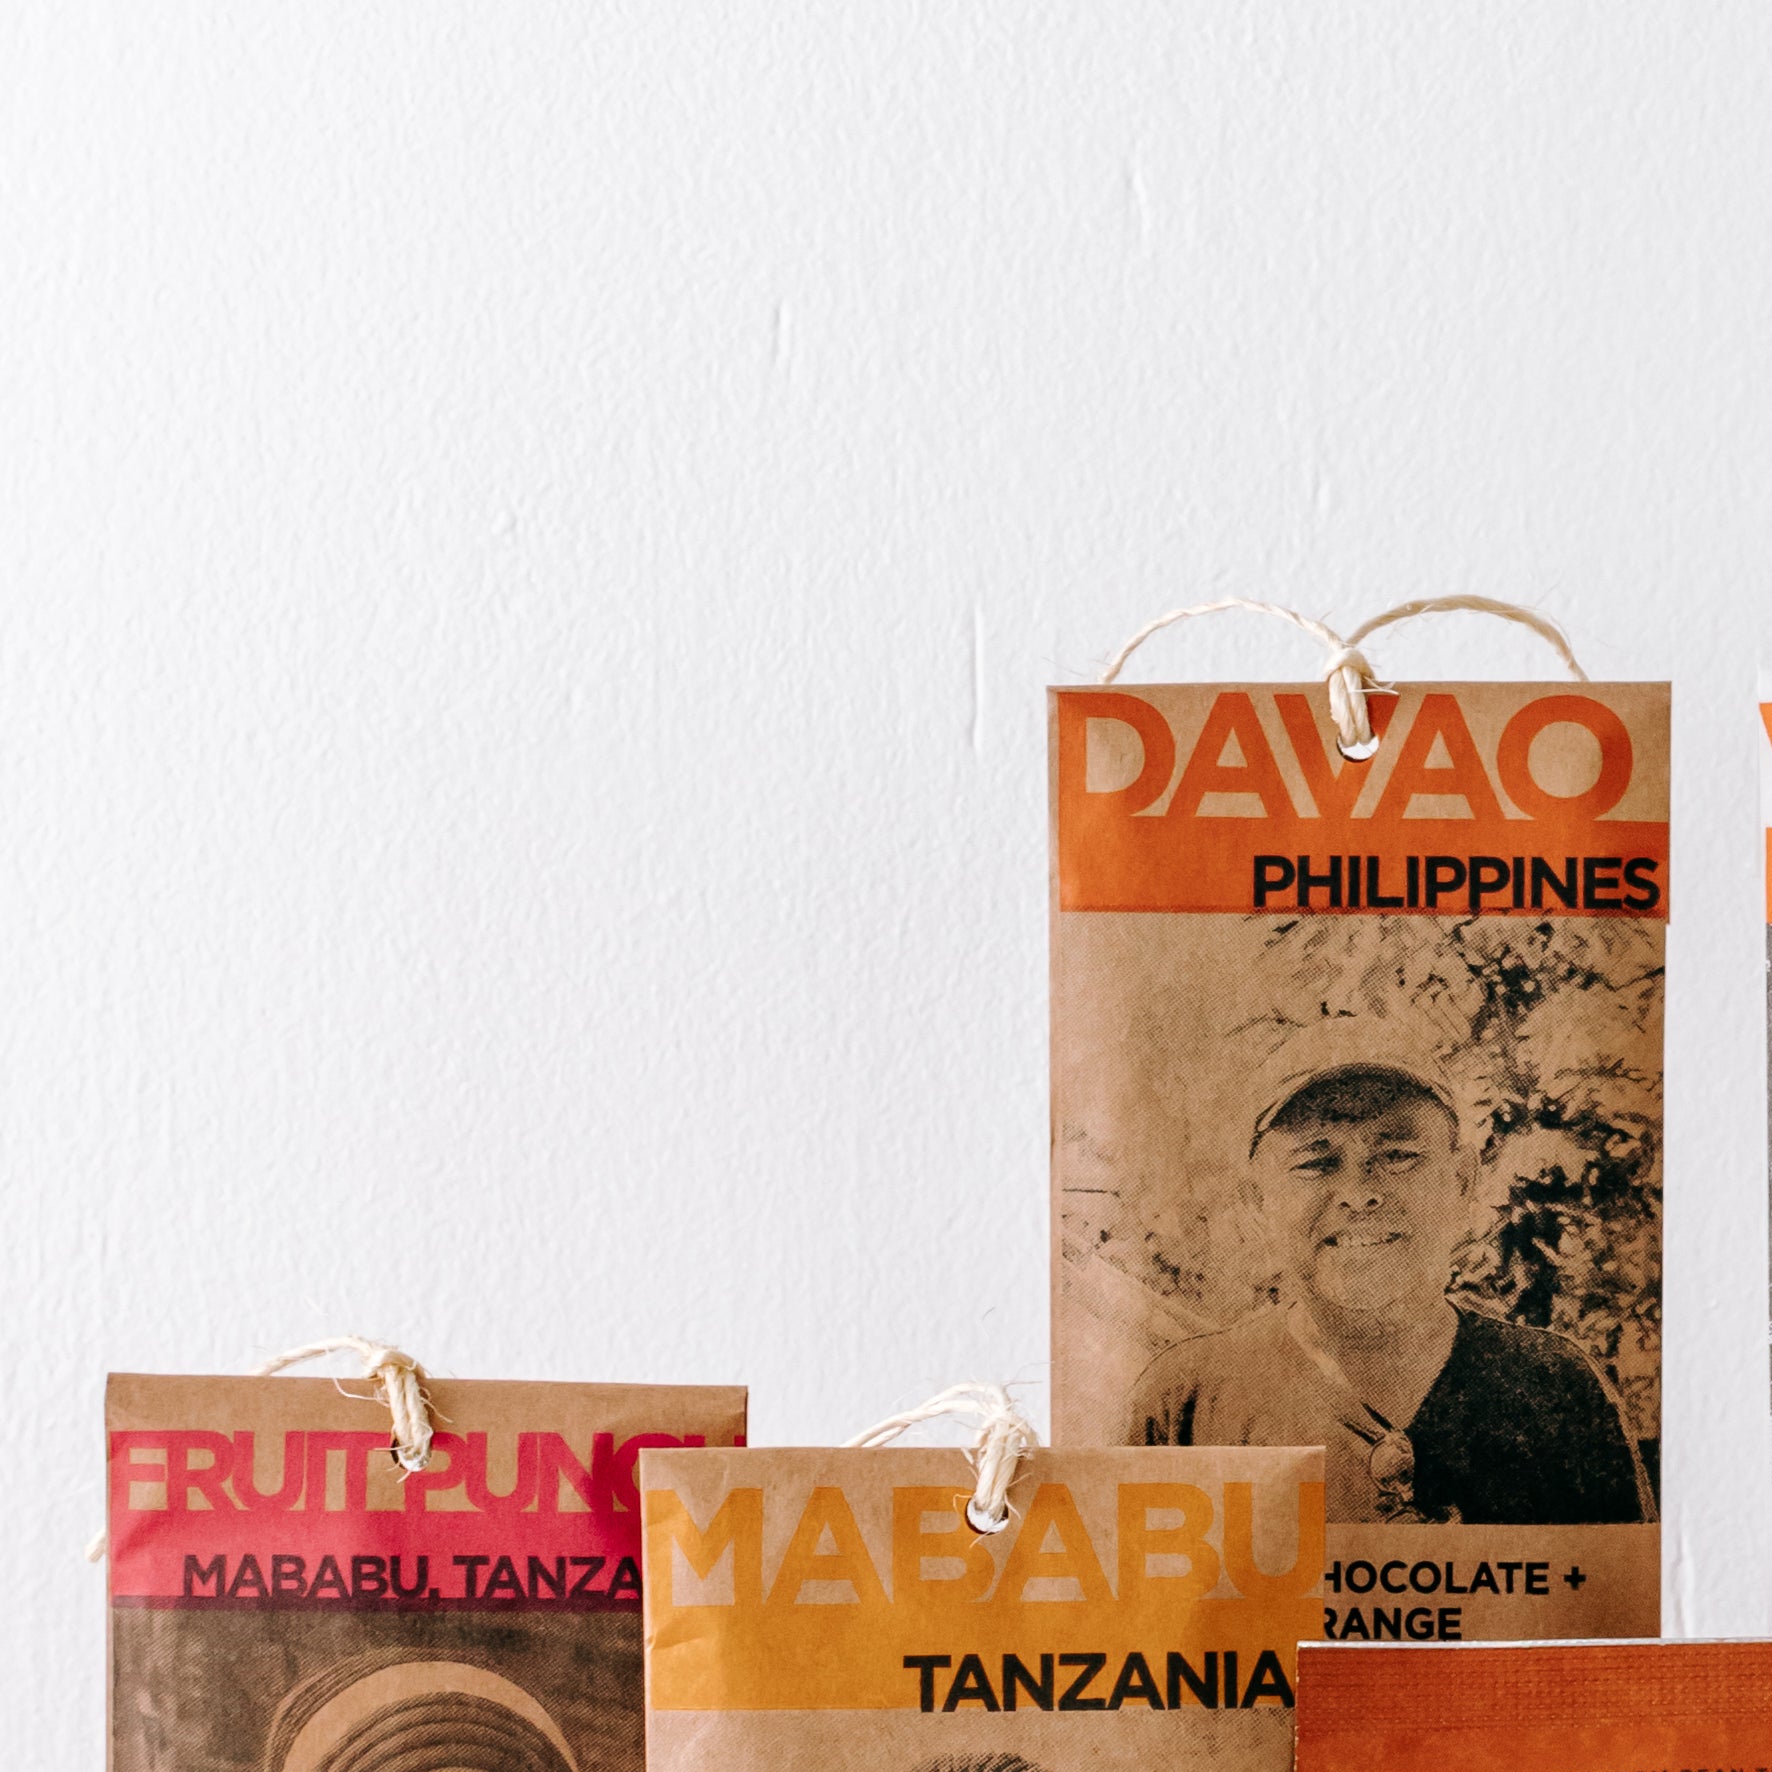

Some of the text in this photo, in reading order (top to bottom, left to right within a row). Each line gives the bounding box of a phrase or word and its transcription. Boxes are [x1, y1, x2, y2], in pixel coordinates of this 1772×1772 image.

[1058, 692, 1634, 820] DAVAO
[1254, 855, 1661, 910] PHILIPPINES
[110, 1430, 394, 1512] FRUIT
[645, 1482, 1325, 1606] MABABU
[1564, 1566, 1586, 1590] +
[903, 1650, 1295, 1713] TANZANIA
